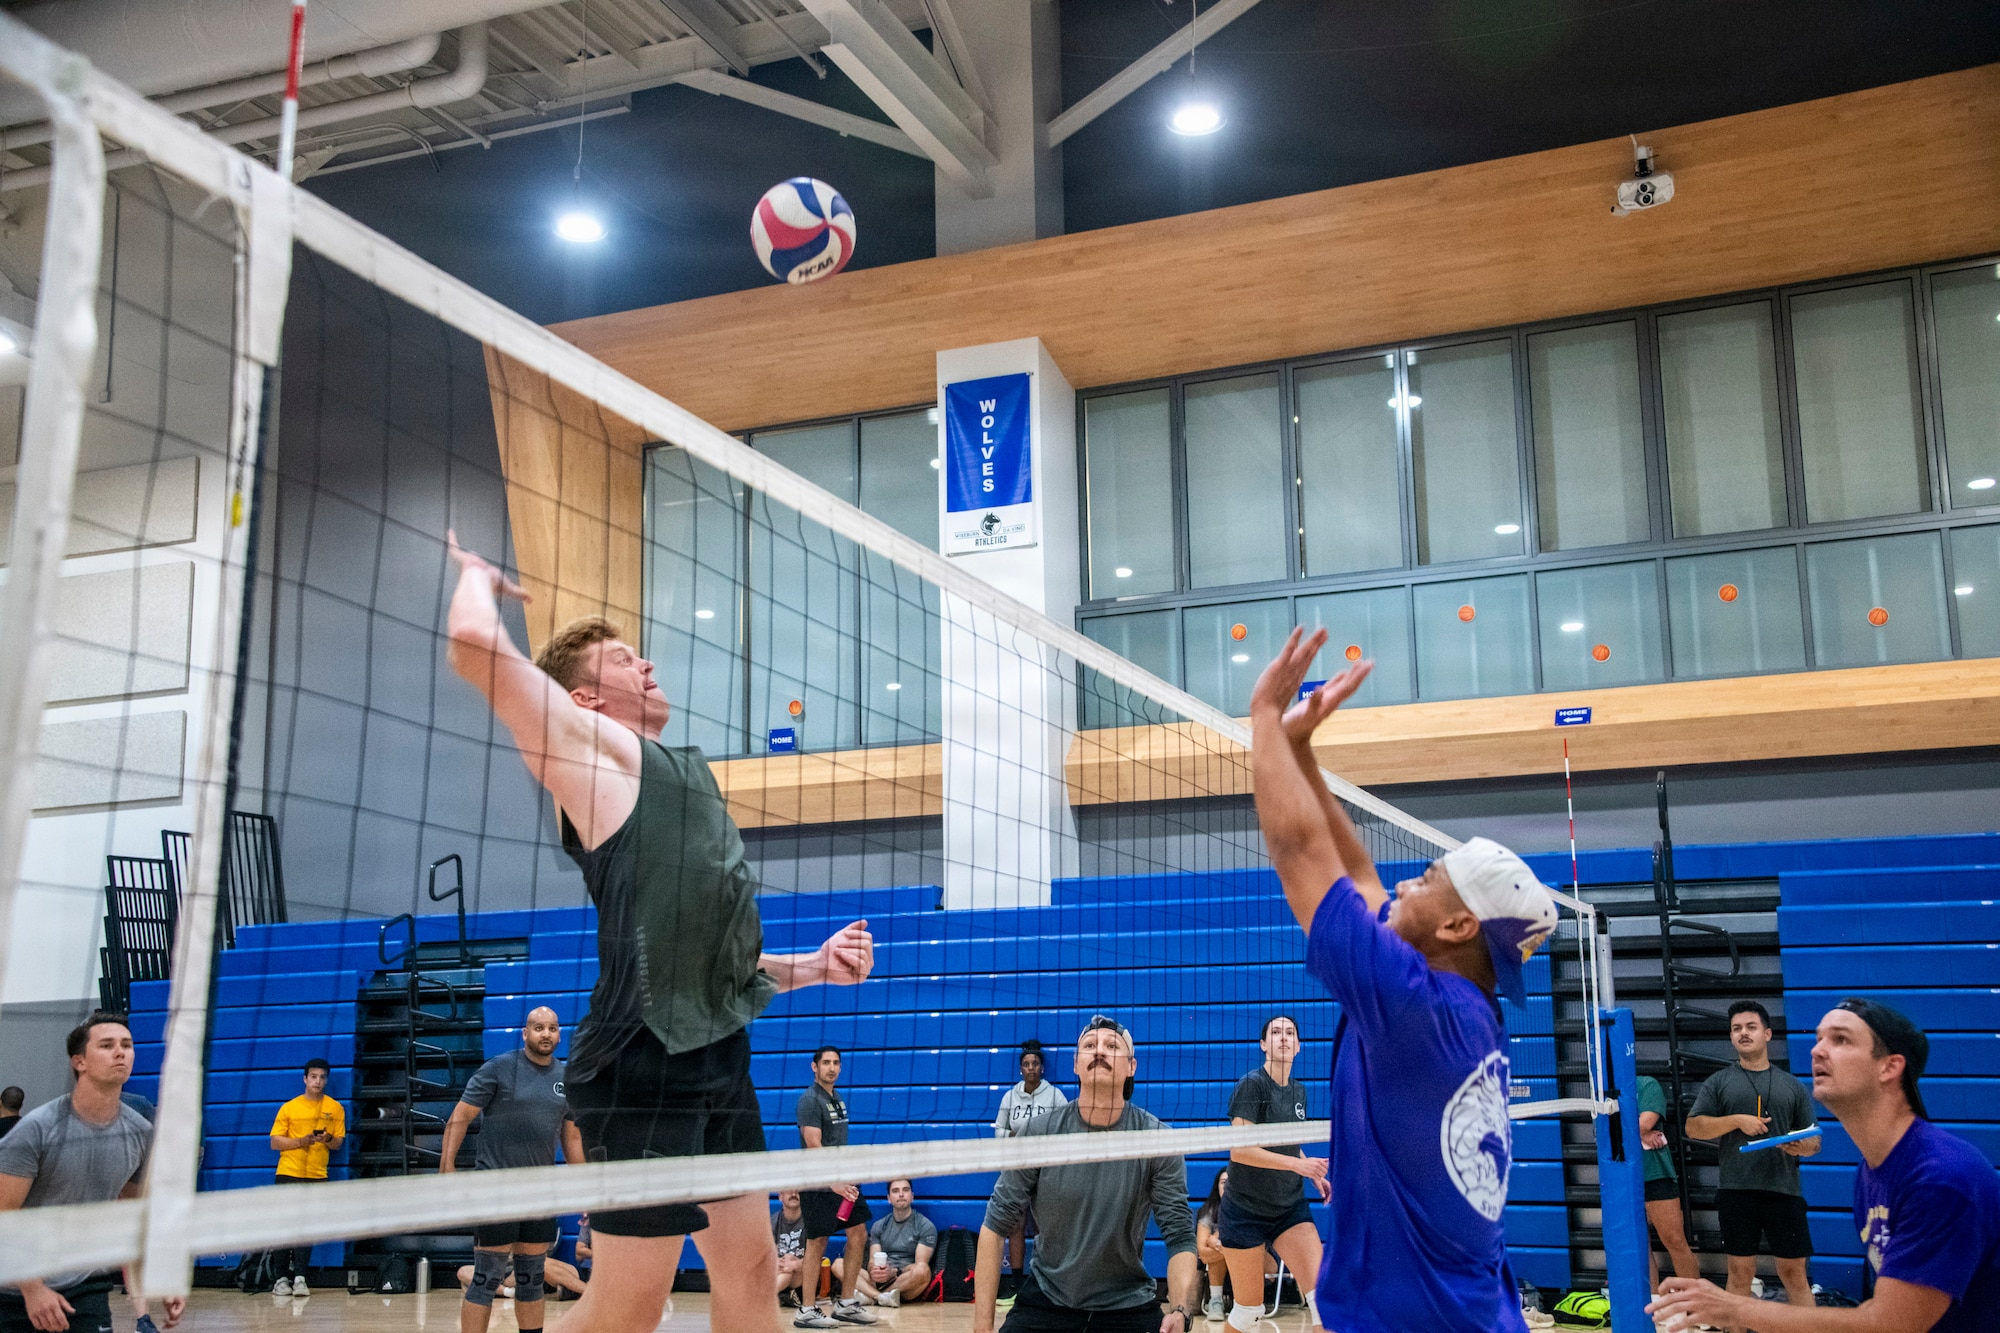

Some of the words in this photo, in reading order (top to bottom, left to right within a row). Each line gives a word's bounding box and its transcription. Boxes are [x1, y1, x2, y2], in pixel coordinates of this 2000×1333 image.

[798, 257, 834, 278] NCAA
[979, 399, 996, 492] WOLVES
[975, 535, 1007, 546] ATHLETICS
[771, 736, 793, 744] HOME
